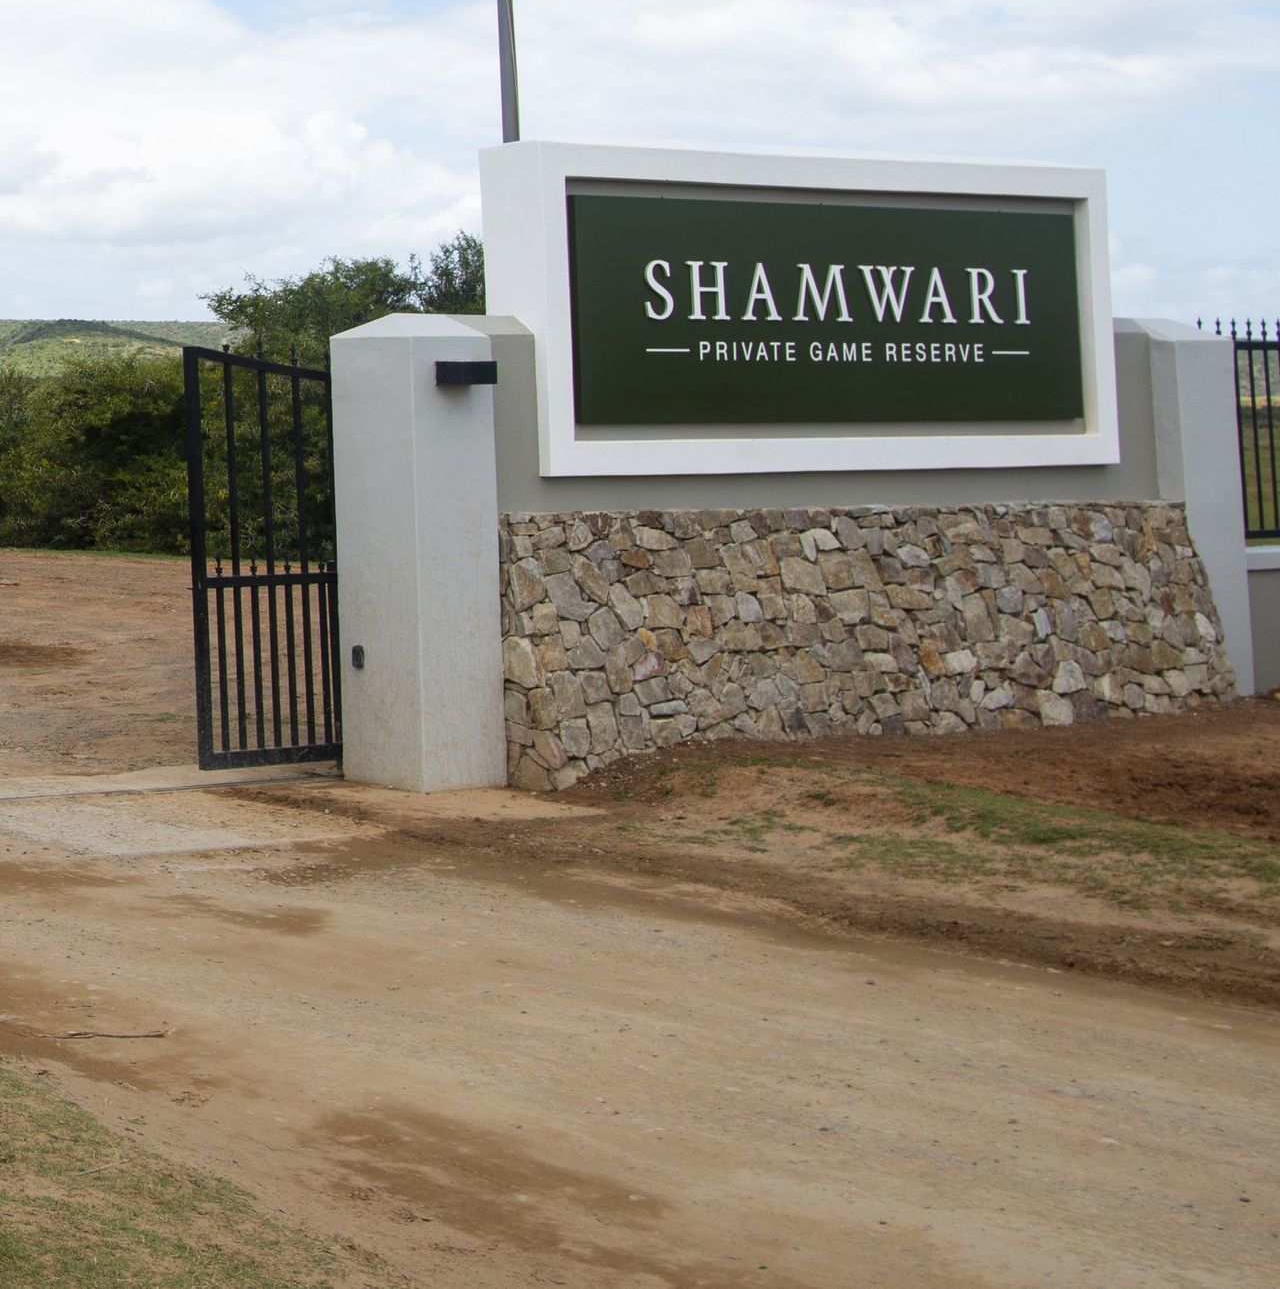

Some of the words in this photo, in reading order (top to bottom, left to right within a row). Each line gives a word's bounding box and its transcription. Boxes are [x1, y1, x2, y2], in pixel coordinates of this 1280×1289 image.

[643, 258, 1031, 325] SHAMWARI
[698, 340, 797, 362] PRIVATE
[809, 341, 873, 362] GAME
[884, 342, 985, 363] RESERVE
